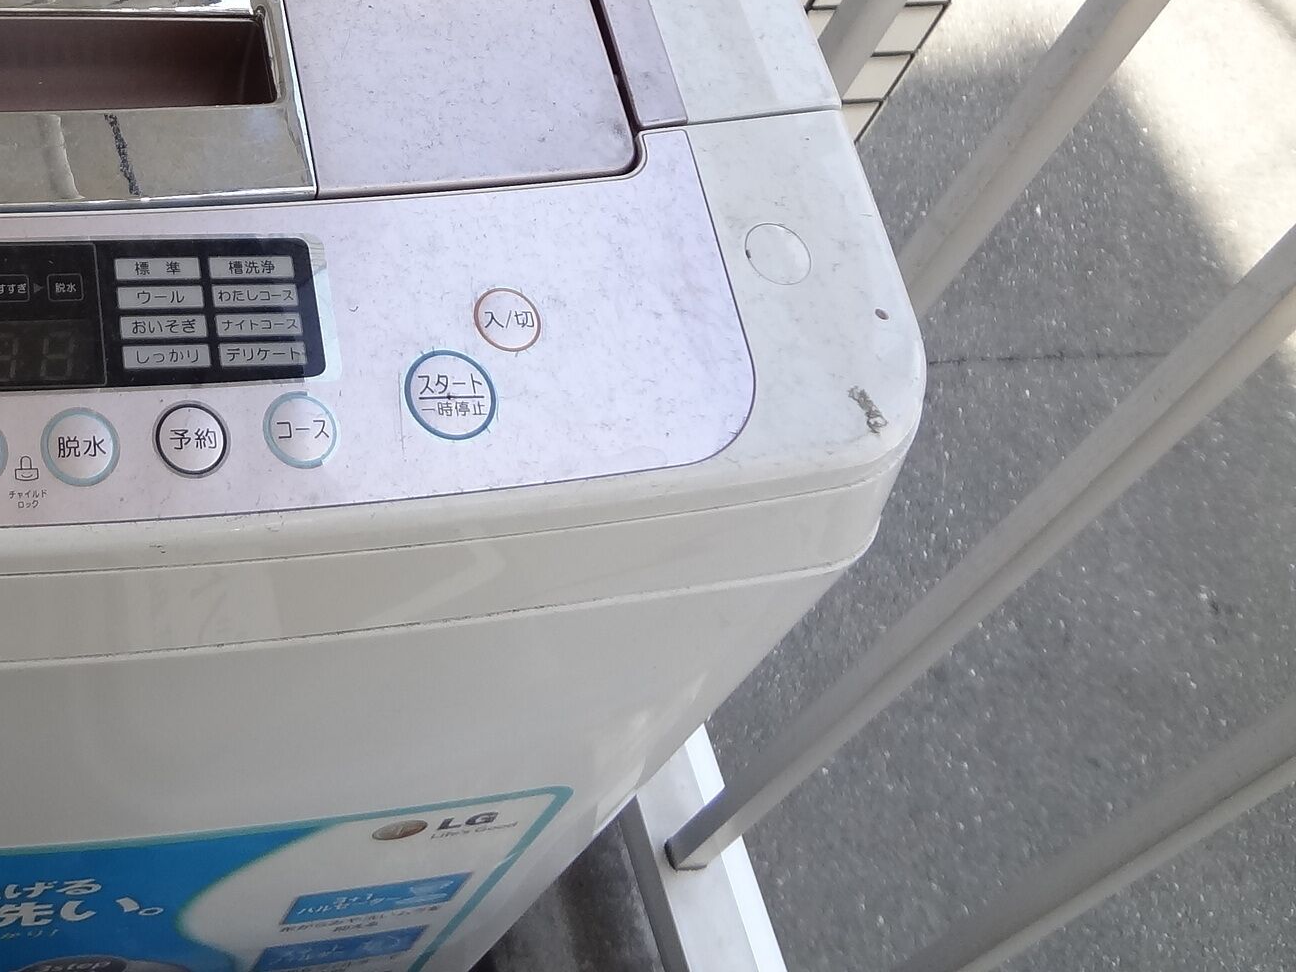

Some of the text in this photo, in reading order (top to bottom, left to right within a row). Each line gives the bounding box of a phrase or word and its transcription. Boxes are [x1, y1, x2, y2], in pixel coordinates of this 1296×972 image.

[135, 260, 181, 276] 標準
[228, 259, 275, 275] 槽洗浄
[54, 281, 77, 293] 脱水
[217, 288, 295, 302] わたしコース
[136, 289, 185, 305] ウール
[131, 317, 197, 335] おいそぎ
[221, 317, 299, 332] ナイトコース
[483, 308, 535, 330] 入/切
[135, 347, 200, 364] しっかり
[226, 346, 302, 363] デリケート
[417, 371, 484, 397] スタート
[420, 400, 488, 419] 一時停止
[274, 418, 331, 442] コース
[57, 434, 107, 458] 脱水
[170, 427, 218, 452] 予約
[8, 488, 48, 500] チャイルド
[17, 499, 39, 509] ロック
[437, 811, 500, 831] LG
